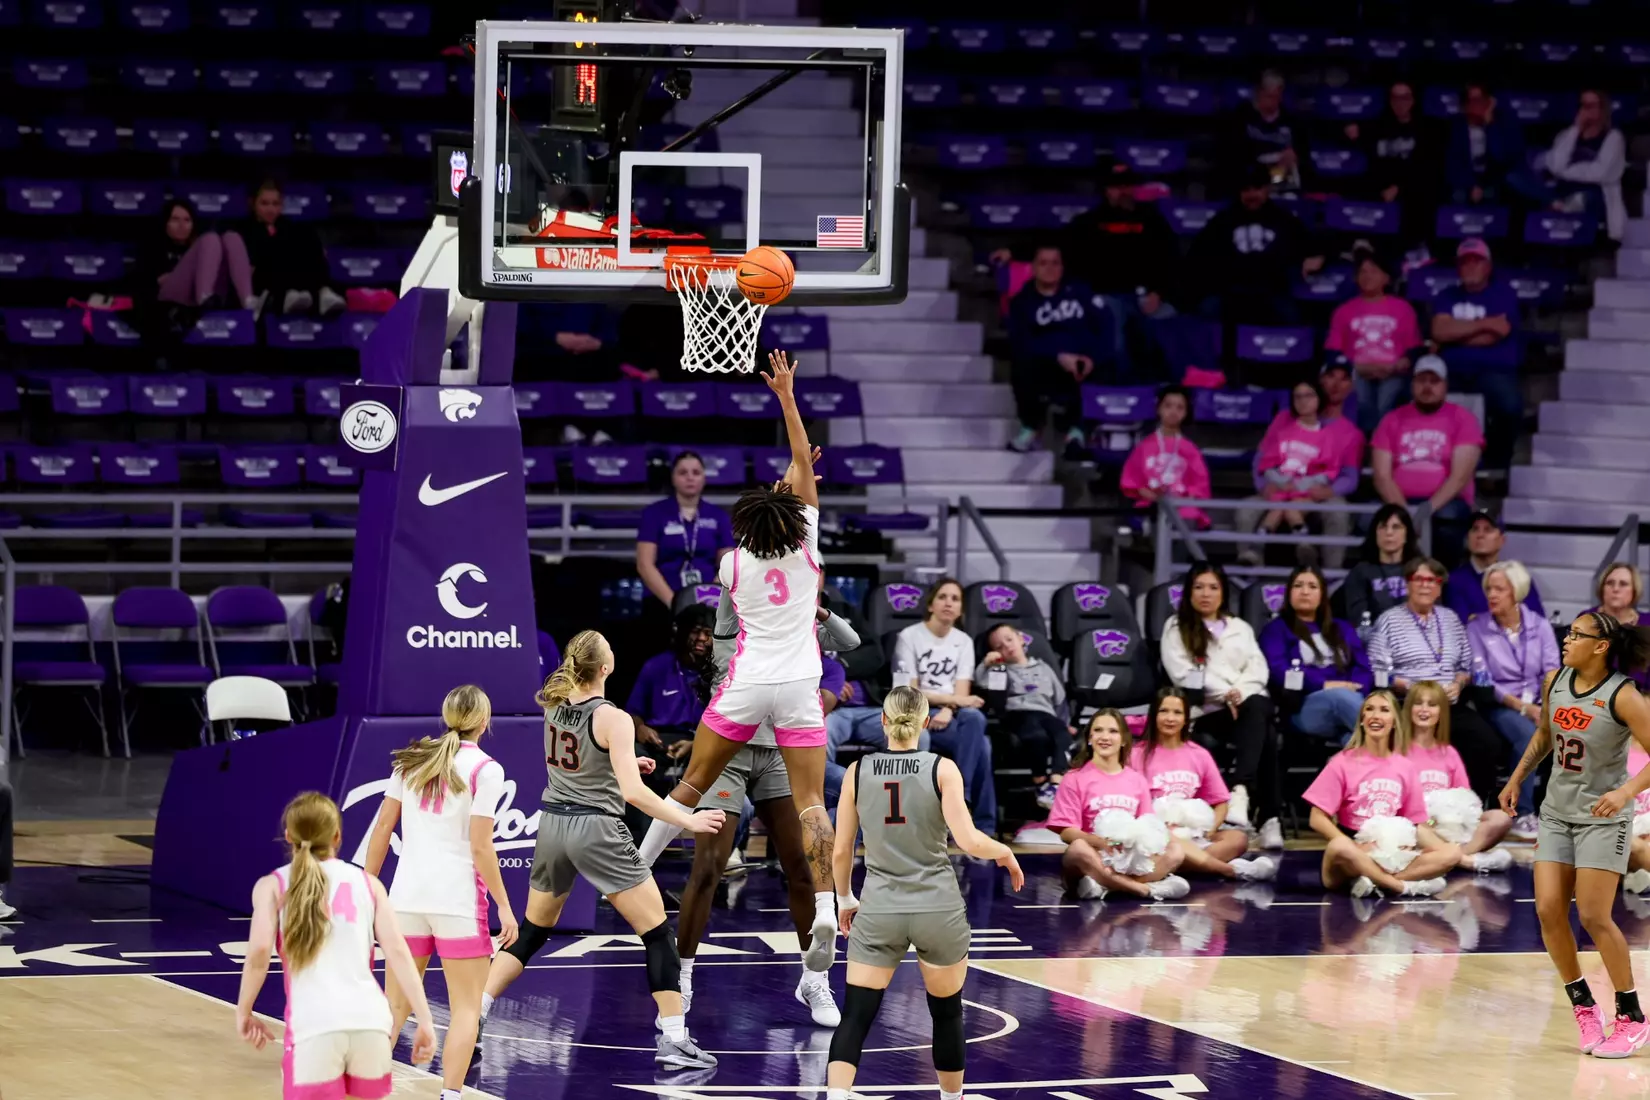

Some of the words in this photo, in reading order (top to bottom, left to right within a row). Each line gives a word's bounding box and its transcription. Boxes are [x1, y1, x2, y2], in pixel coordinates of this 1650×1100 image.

[561, 247, 589, 269] State
[590, 247, 617, 270] Farm
[492, 272, 533, 283] SPALDING
[352, 409, 385, 442] Ford
[764, 568, 791, 606] 3
[1553, 706, 1594, 730] OSU
[547, 724, 580, 771] 13
[1556, 733, 1585, 772] 32
[873, 759, 920, 775] WHITING
[1359, 778, 1402, 795] K-STATE
[884, 782, 906, 824] 1
[1090, 794, 1140, 812] K-STATE
[498, 857, 522, 868] OOD
